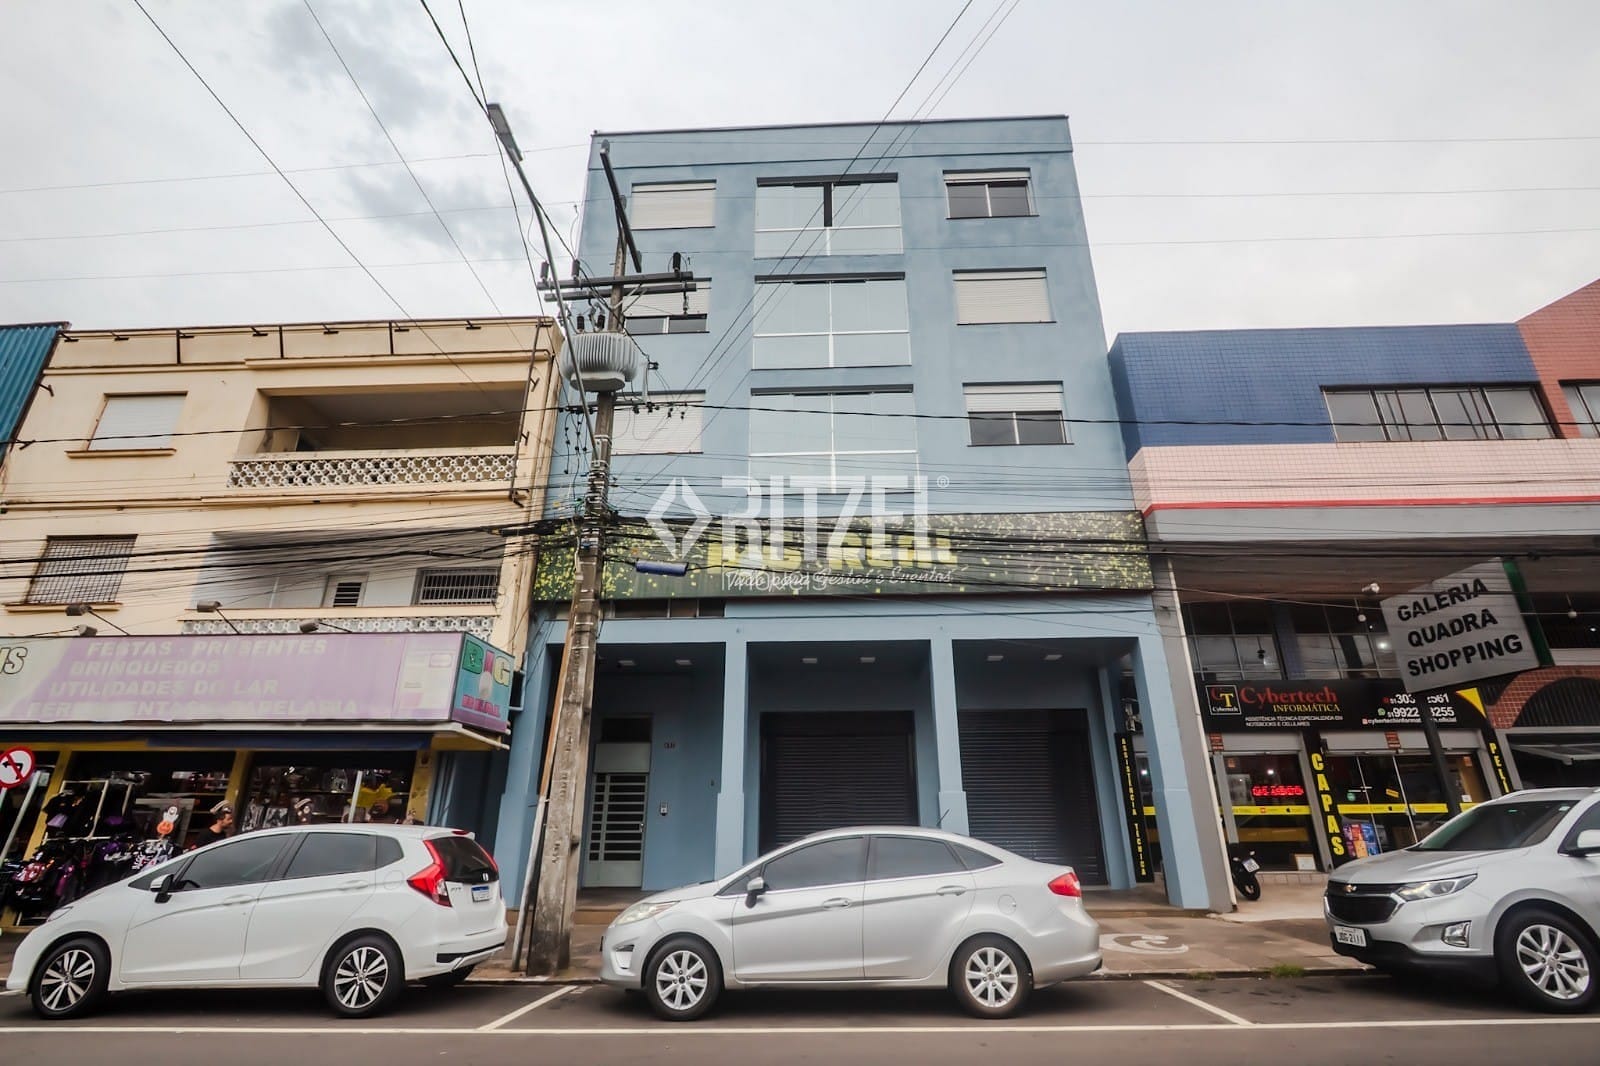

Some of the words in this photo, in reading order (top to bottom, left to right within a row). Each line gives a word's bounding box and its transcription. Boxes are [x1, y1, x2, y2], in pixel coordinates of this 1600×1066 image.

[1397, 578, 1488, 622] GALERIA
[1407, 608, 1498, 647] QUADRA
[87, 640, 172, 656] FESTAS
[1407, 634, 1523, 677] SHOPPING
[50, 680, 185, 698] UTILIDADES
[233, 679, 278, 696] LAR
[1240, 686, 1338, 709] Cybertech
[1272, 703, 1341, 713] INFORMÁTICA
[1311, 752, 1345, 856] CAPAS
